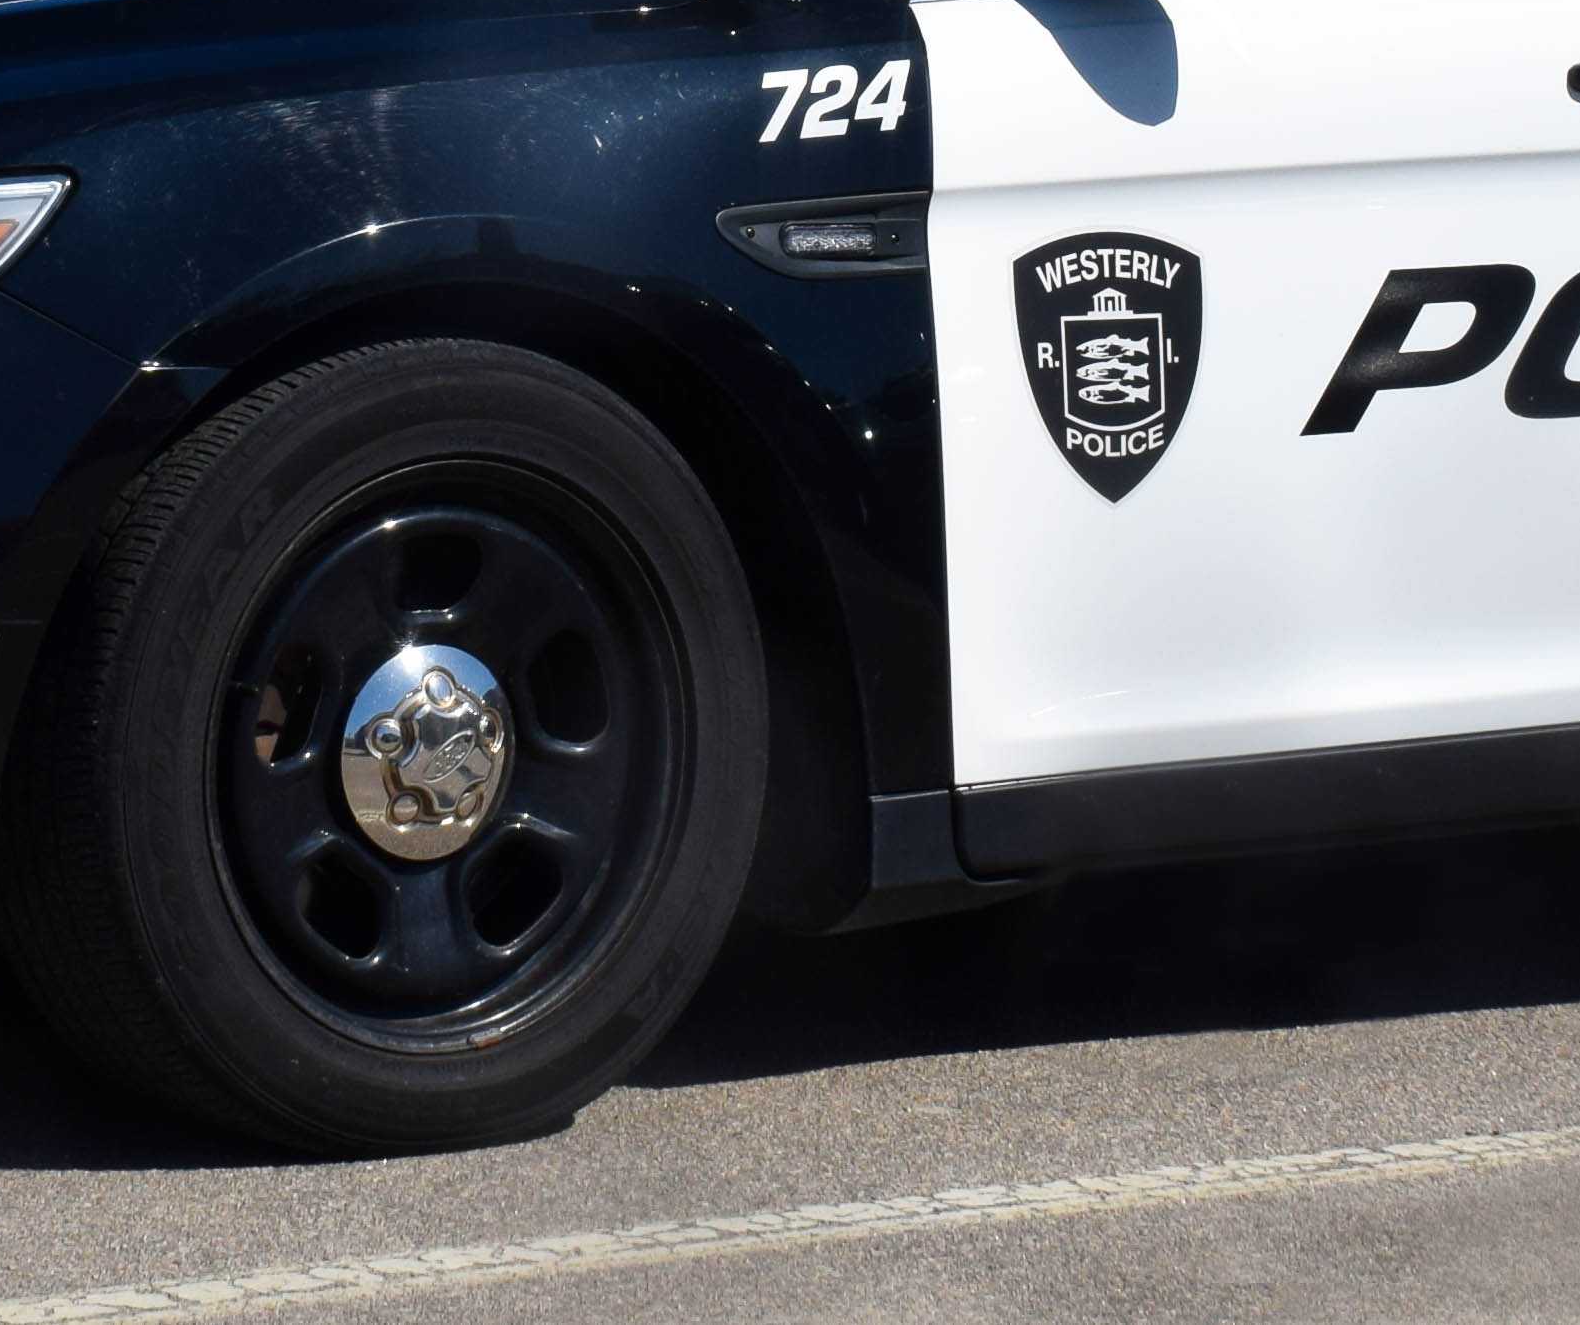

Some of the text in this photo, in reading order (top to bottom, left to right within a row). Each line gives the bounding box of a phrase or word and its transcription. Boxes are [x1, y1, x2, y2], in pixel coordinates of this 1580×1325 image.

[759, 59, 911, 144] 724
[1034, 247, 1182, 293] WESTERLY
[1037, 337, 1181, 369] R. I.
[1065, 422, 1166, 459] POLICE
